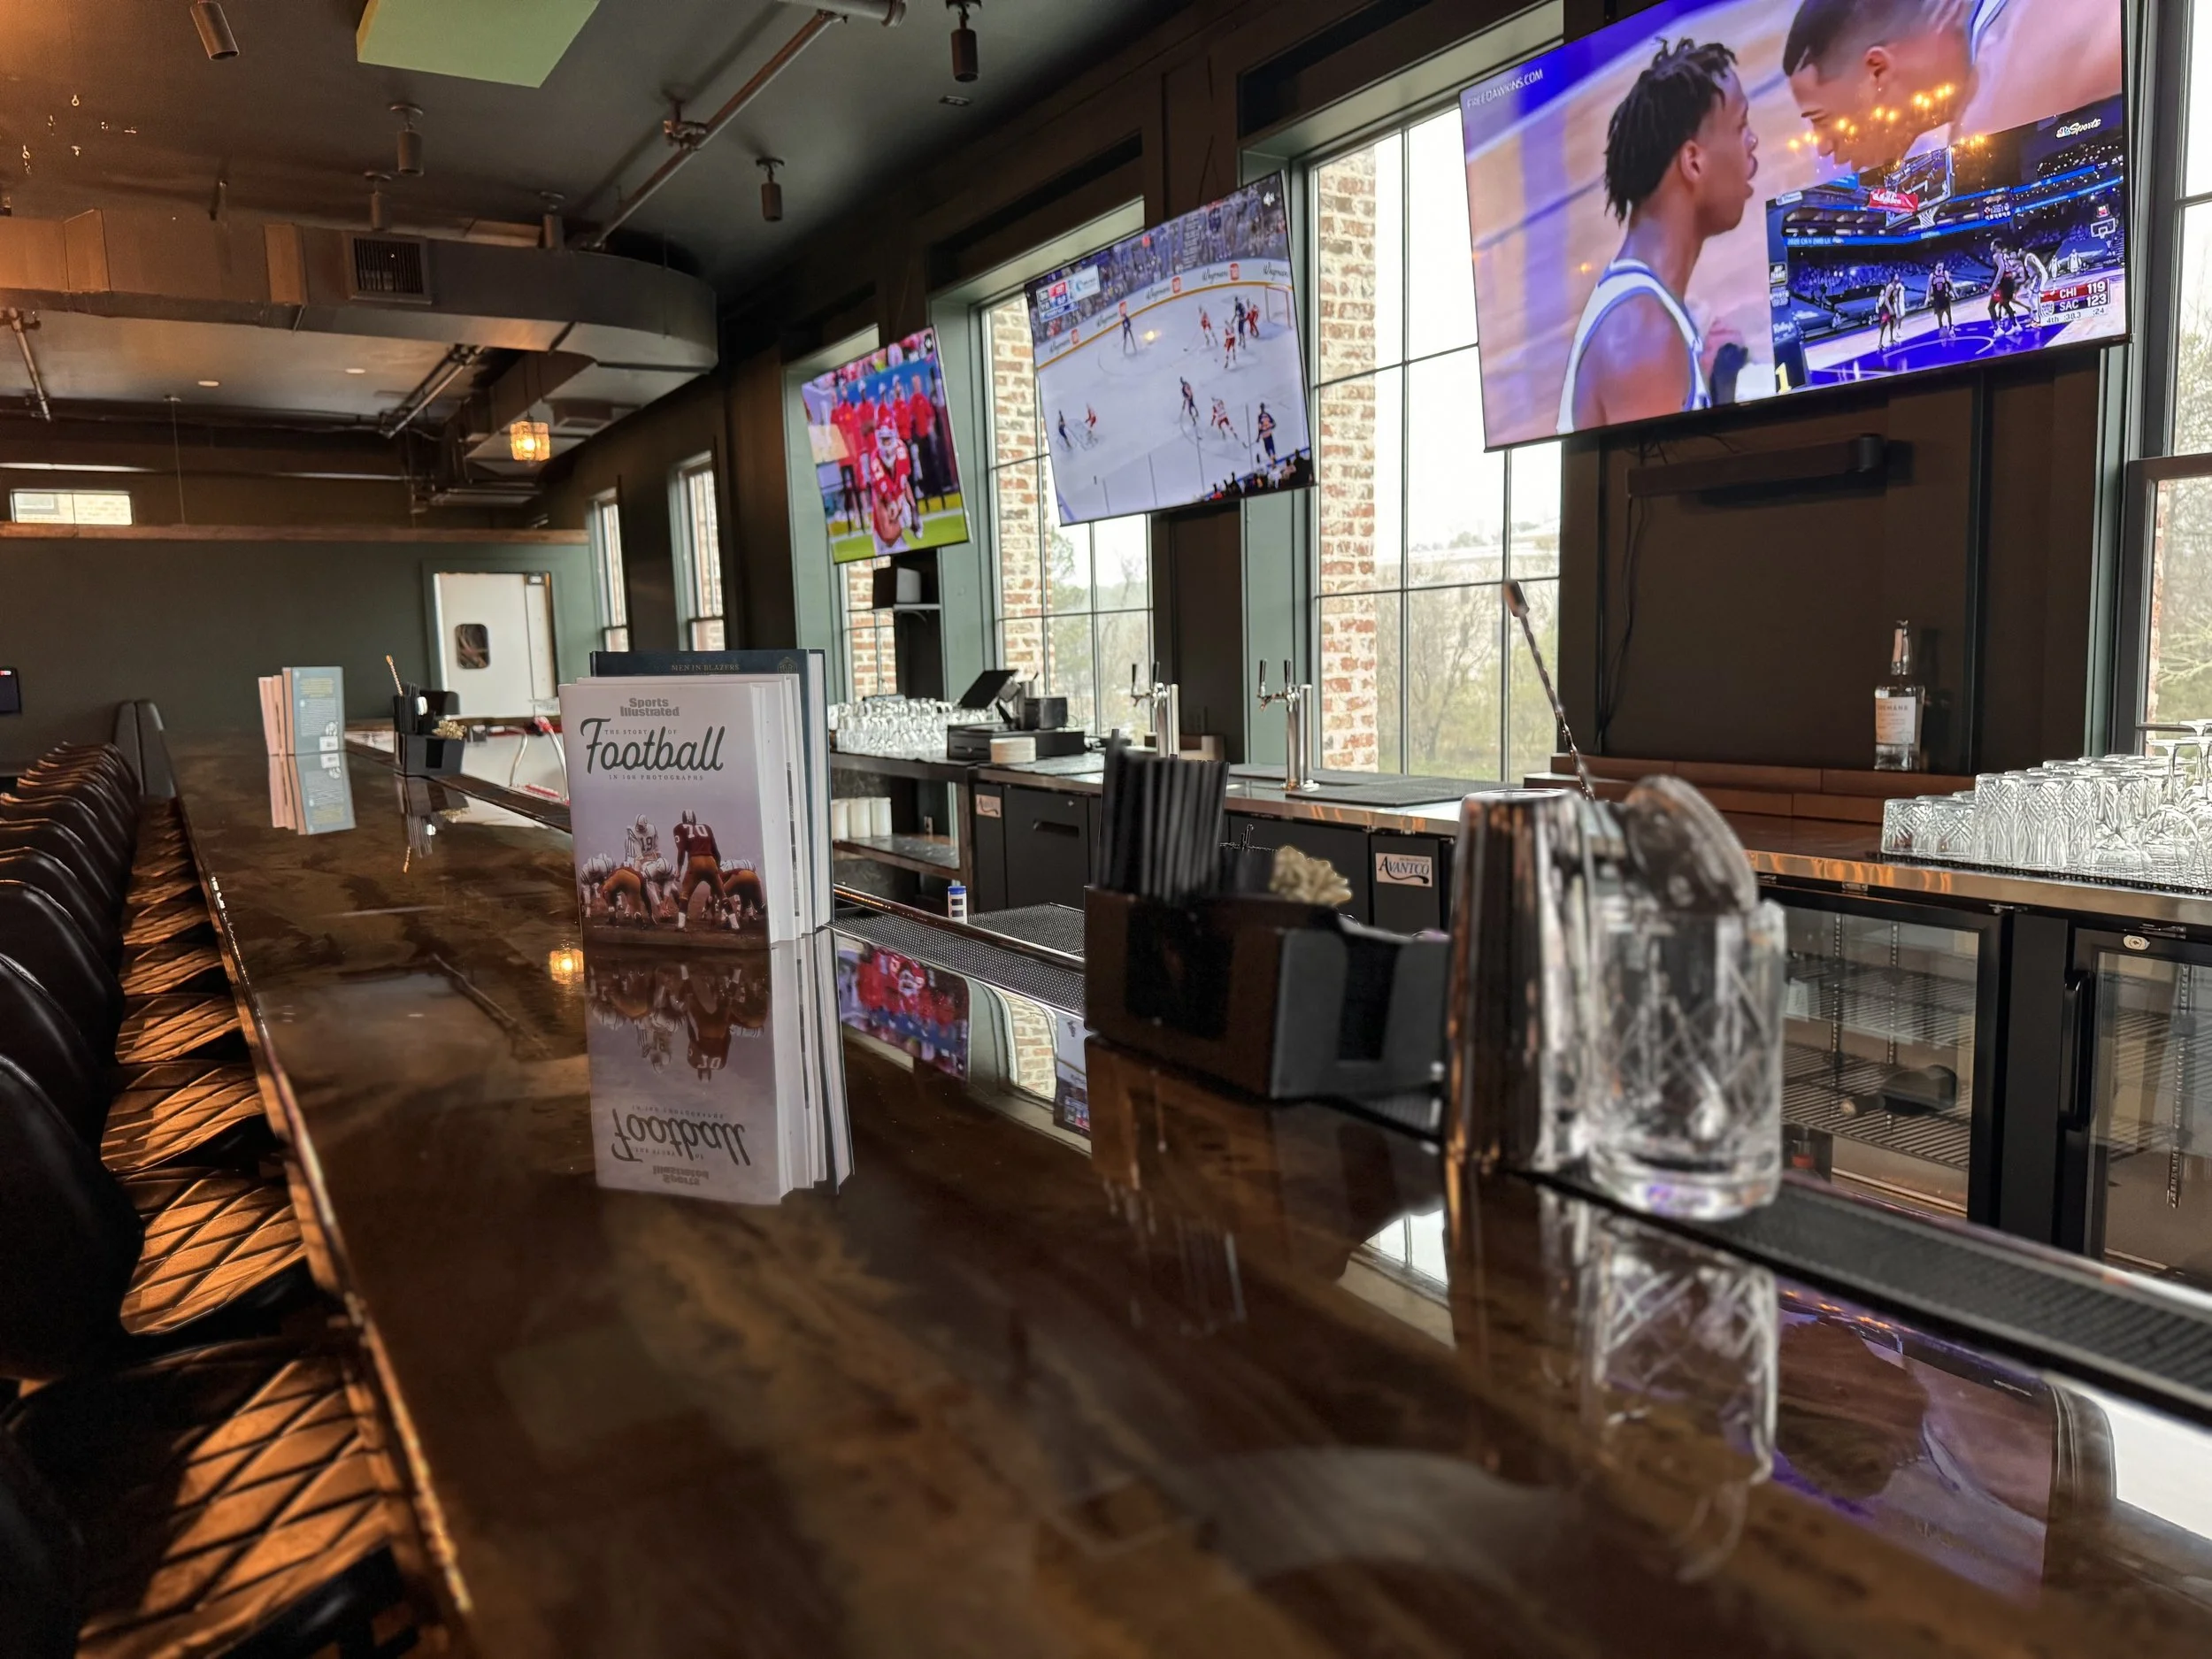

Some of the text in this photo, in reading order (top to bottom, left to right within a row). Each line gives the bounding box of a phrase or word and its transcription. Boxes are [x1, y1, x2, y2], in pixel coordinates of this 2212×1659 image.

[2070, 118, 2101, 135] Sports
[2059, 280, 2106, 299] CHI 119
[2059, 293, 2107, 311] SAC 123
[619, 705, 680, 718] Illustrated
[628, 697, 670, 709] Sports
[580, 717, 726, 775] Football
[682, 823, 709, 839] 70
[640, 835, 653, 851] 19
[1378, 856, 1430, 879] AVANTCO
